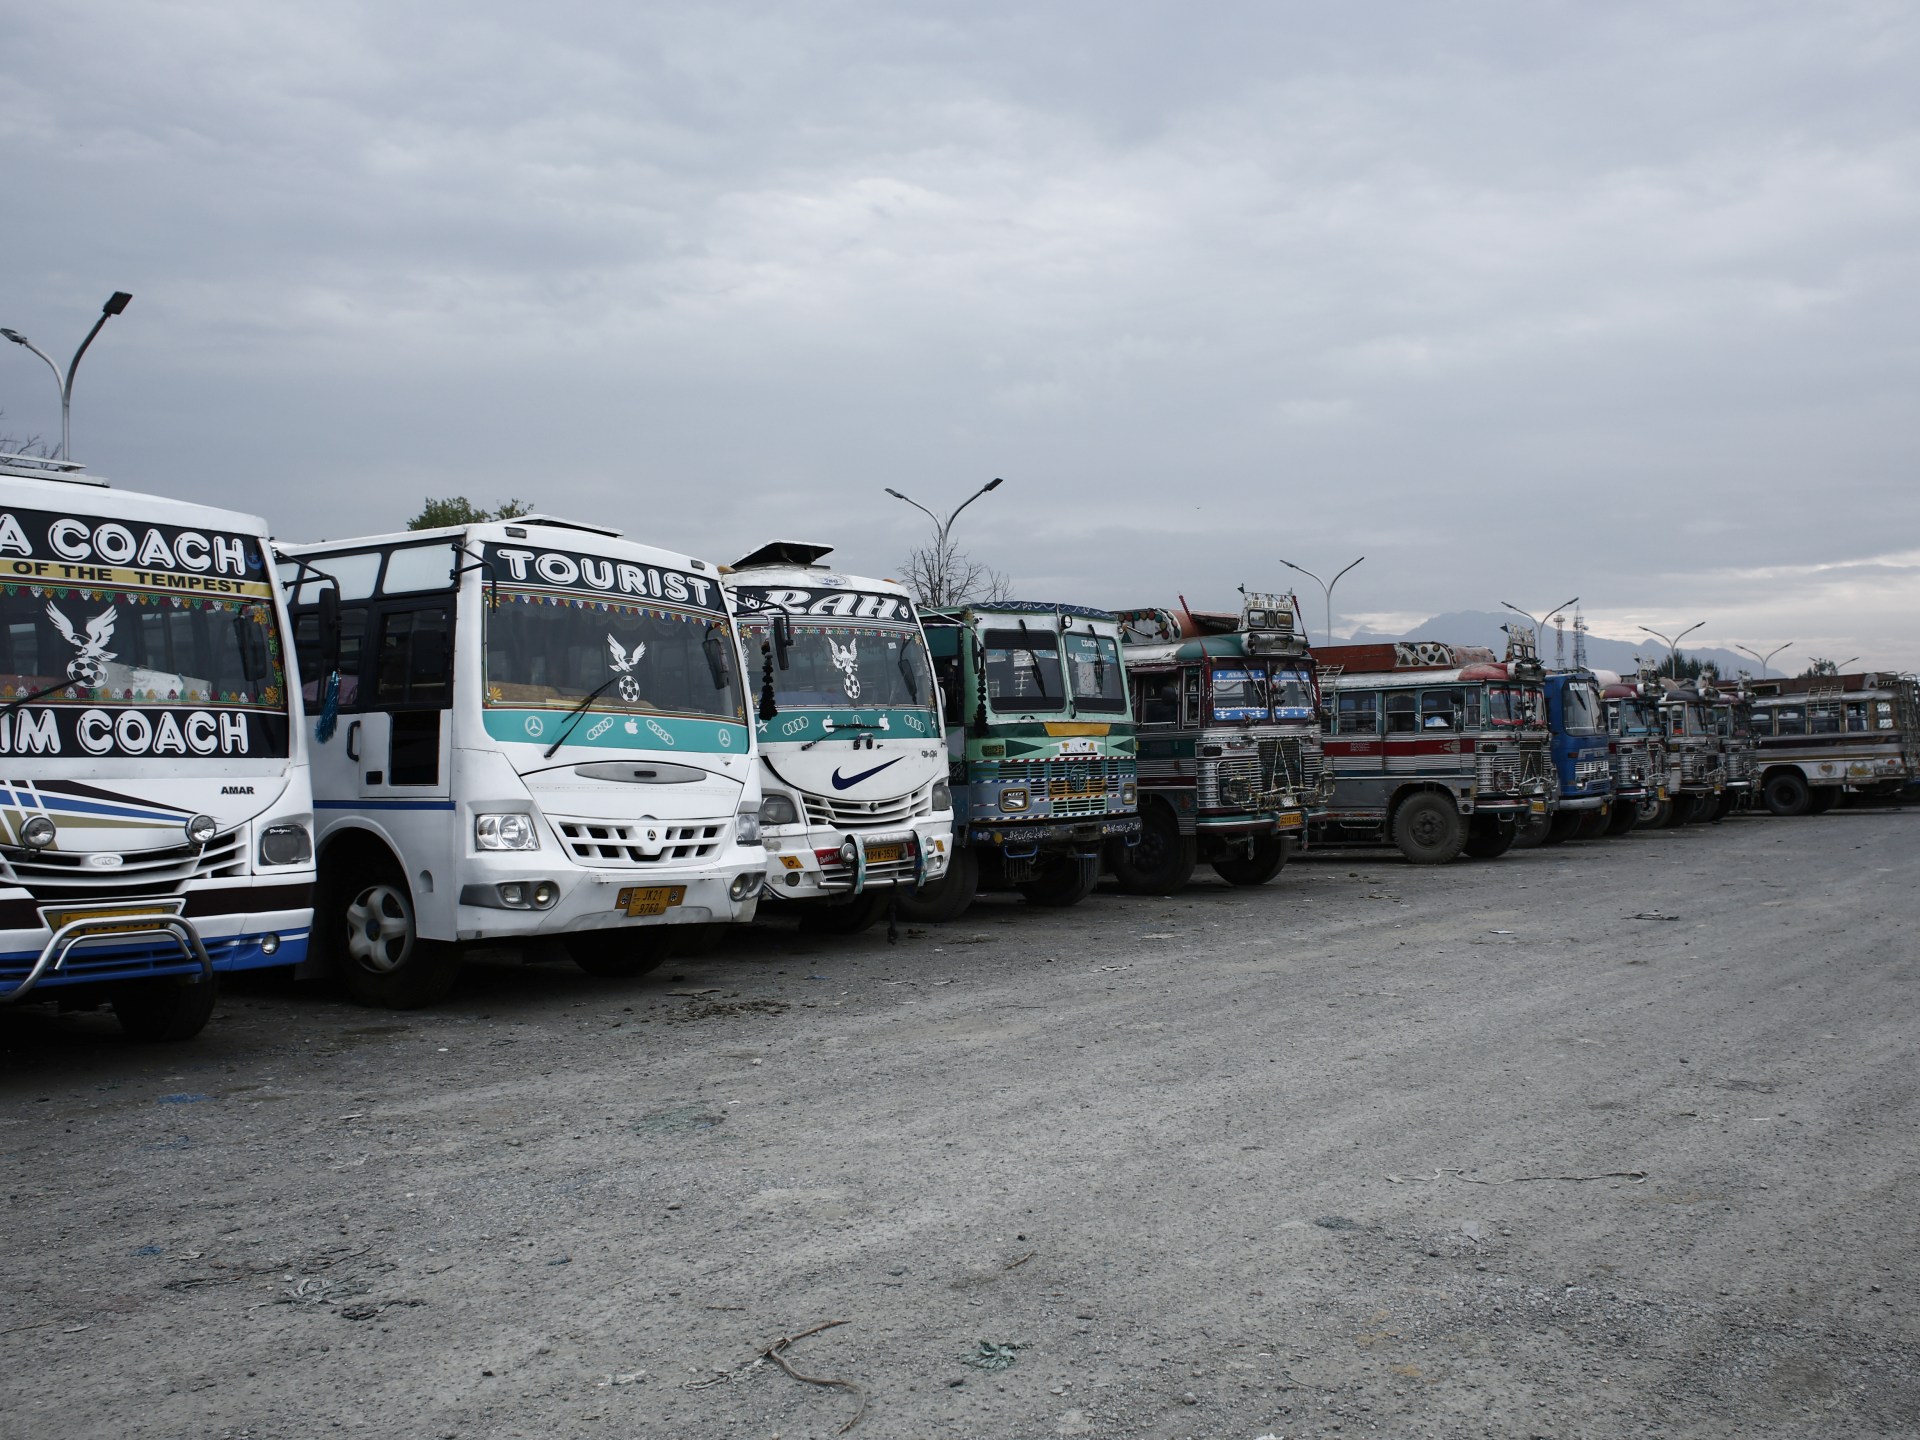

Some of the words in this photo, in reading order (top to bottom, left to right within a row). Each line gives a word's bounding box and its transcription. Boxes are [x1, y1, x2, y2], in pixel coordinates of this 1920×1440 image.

[0, 513, 33, 557] A
[48, 518, 246, 576] COACH
[13, 561, 49, 576] OF
[59, 564, 113, 582] THE
[135, 571, 245, 594] TEMPEST
[497, 549, 711, 606] TOURIST
[760, 589, 899, 620] RAH
[76, 709, 249, 755] COACH
[221, 785, 255, 796] AMAR
[638, 903, 658, 914] 9760
[643, 890, 663, 900] JK21
